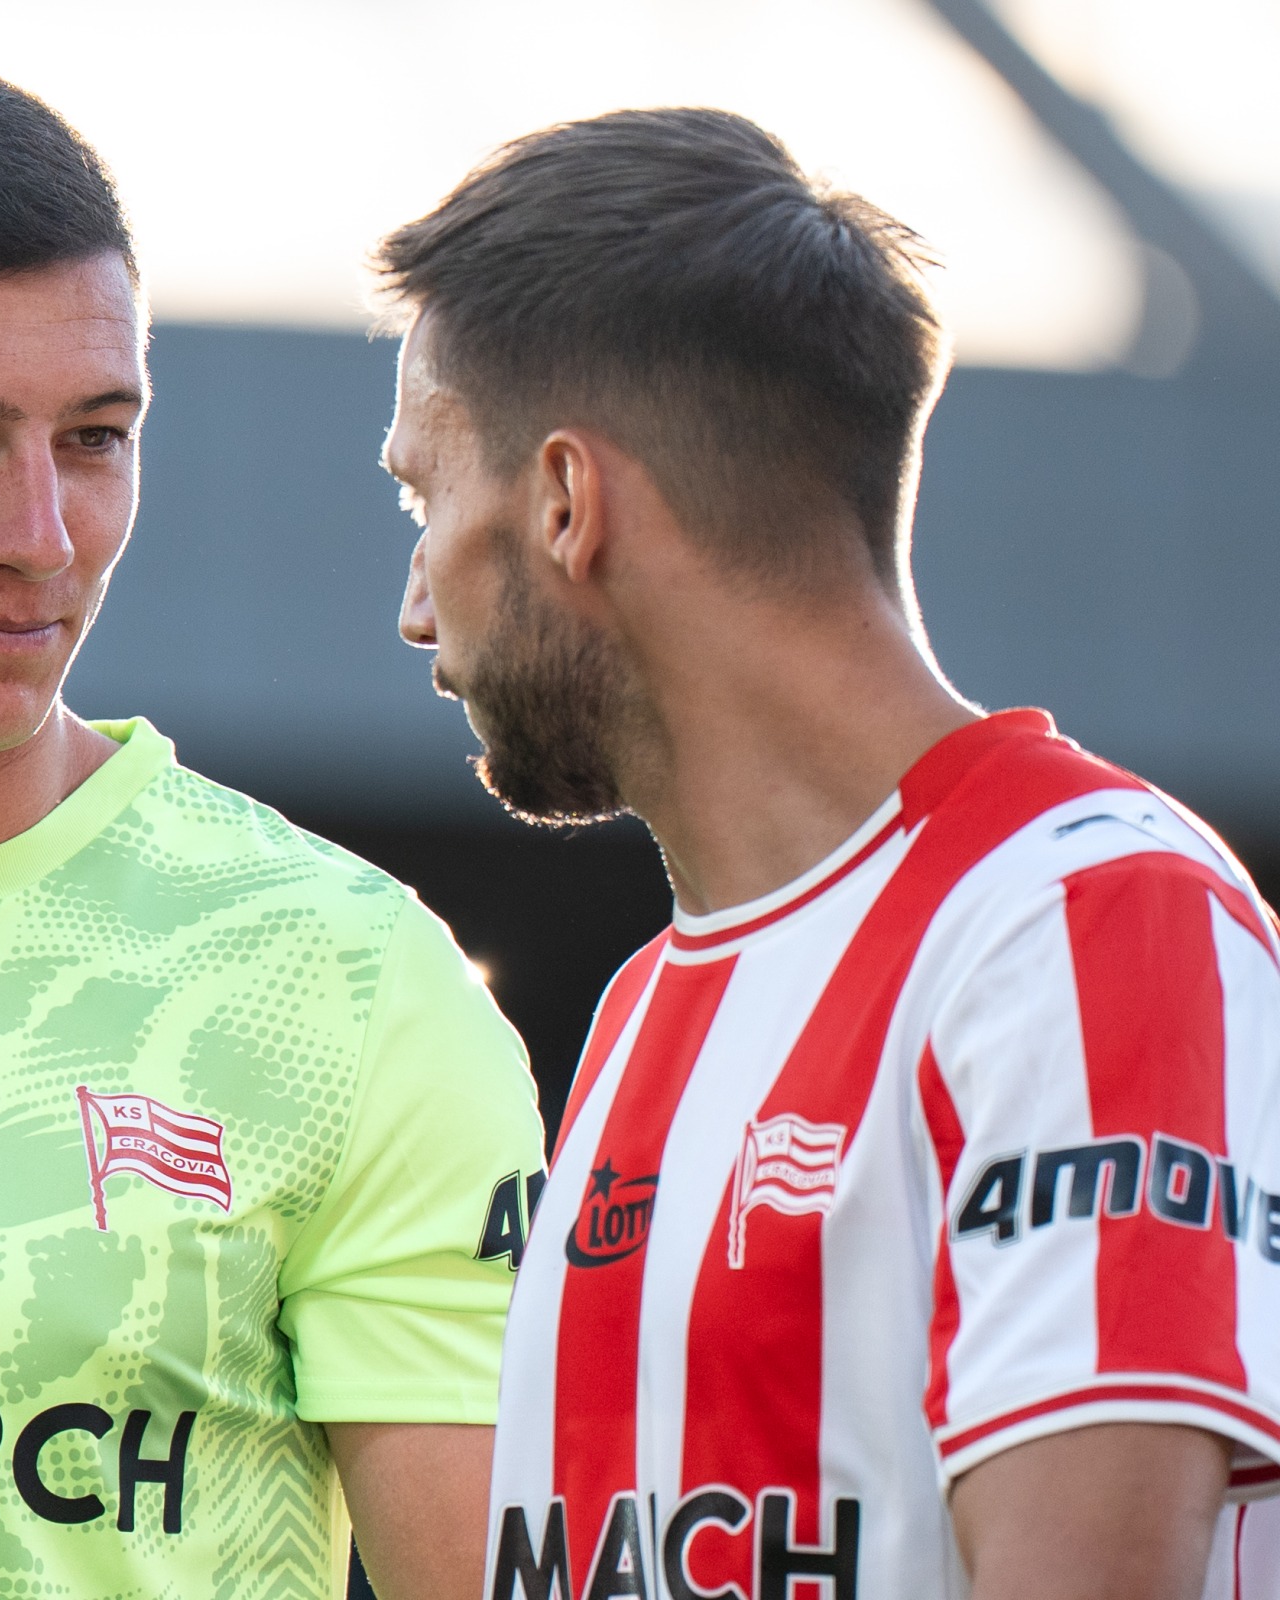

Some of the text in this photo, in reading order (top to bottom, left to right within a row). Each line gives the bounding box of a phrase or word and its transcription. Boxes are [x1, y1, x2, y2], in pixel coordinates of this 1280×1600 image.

[113, 1105, 143, 1120] KS
[119, 1137, 218, 1176] CRACOVIA
[589, 1192, 656, 1248] LOTT
[490, 1485, 861, 1600] MACH
